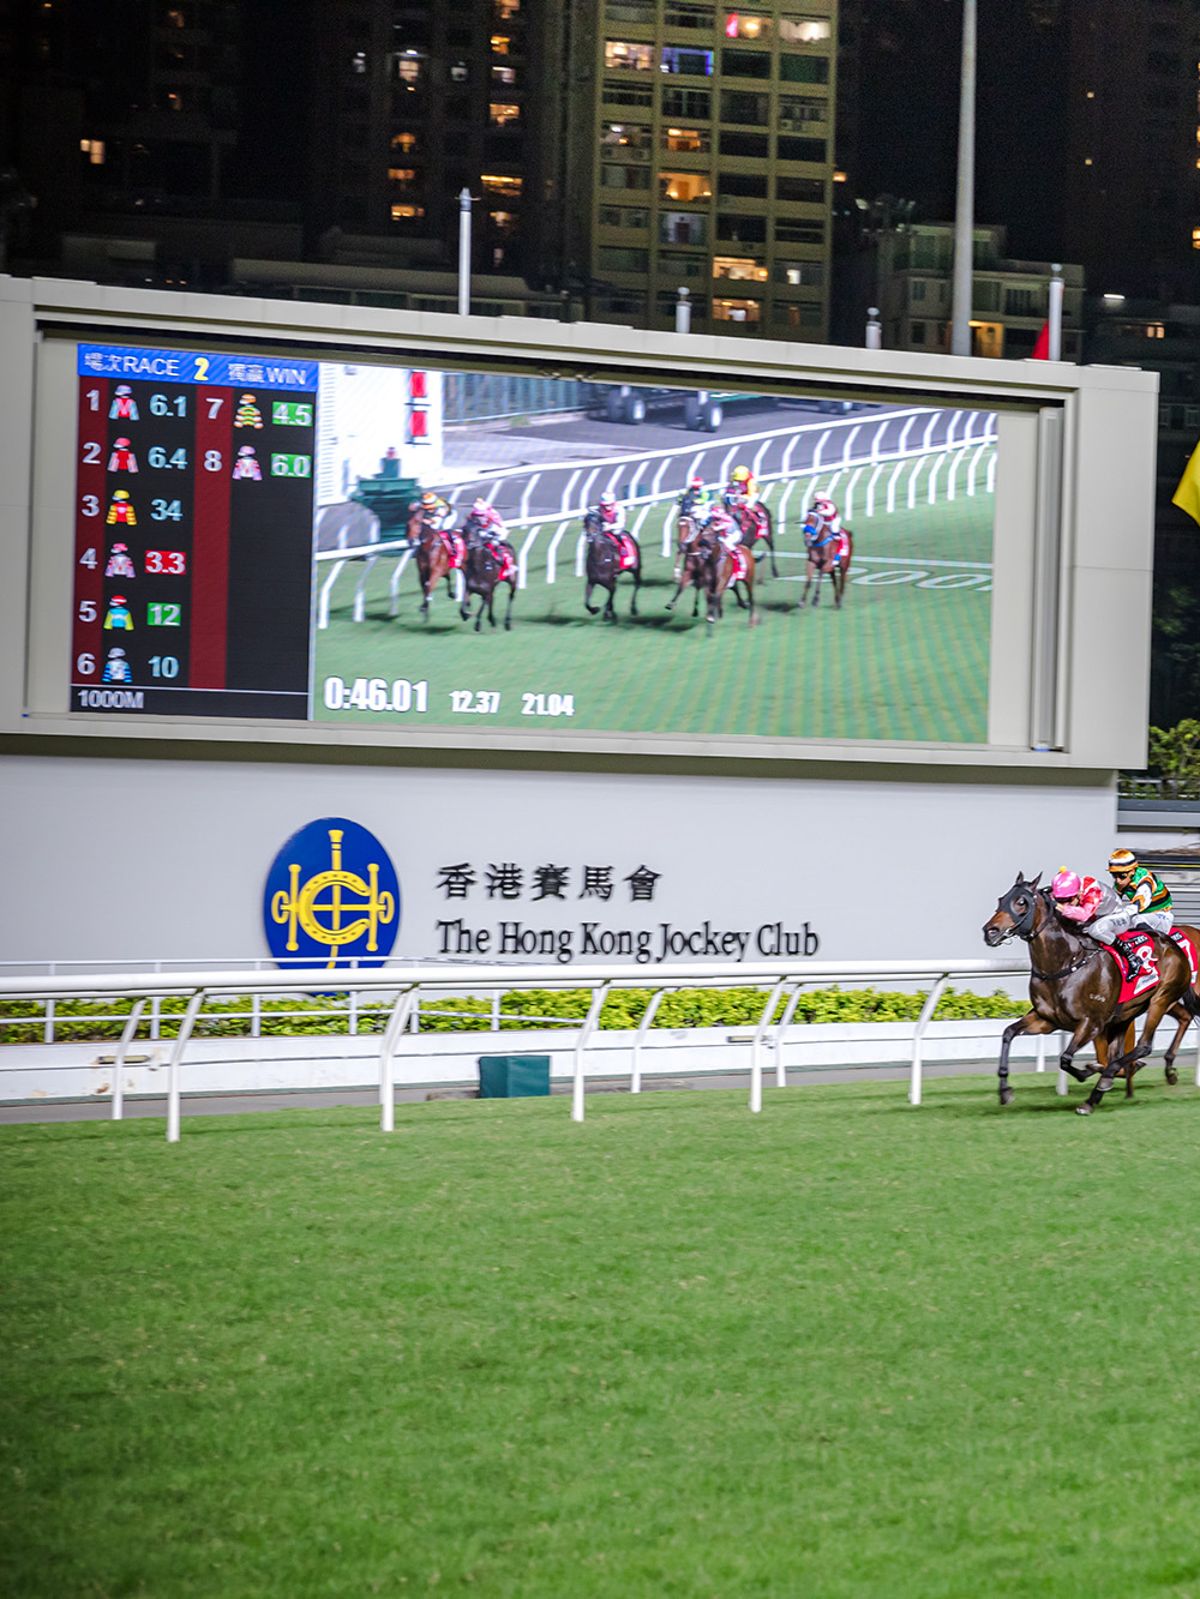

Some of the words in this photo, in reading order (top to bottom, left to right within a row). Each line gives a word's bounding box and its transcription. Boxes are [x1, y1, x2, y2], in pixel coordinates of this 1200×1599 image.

[193, 357, 209, 381] 2
[266, 367, 306, 385] WIN
[86, 389, 100, 411] 1
[149, 394, 187, 417] 6.1
[206, 398, 224, 419] 7
[272, 403, 312, 426] 4.5
[82, 442, 101, 464] 2
[148, 446, 188, 470] 6.4
[204, 450, 222, 472] 8
[272, 455, 311, 477] 6.0
[81, 495, 100, 517] 3
[151, 499, 183, 522] 34
[79, 548, 98, 569] 4
[146, 551, 185, 574] 3.3
[79, 601, 97, 622] 5
[151, 604, 180, 626] 12
[77, 653, 96, 675] 6
[148, 656, 179, 678] 10
[78, 690, 144, 709] 1000M
[324, 677, 428, 712] 0:46.01
[449, 690, 500, 714] 12.37
[521, 692, 575, 716] 21.04
[436, 862, 662, 902] 香港賽馬會
[435, 918, 491, 954] The
[498, 921, 574, 964] Hong
[581, 922, 652, 964] Kong
[656, 921, 751, 963] Jockey
[757, 921, 819, 956] Club
